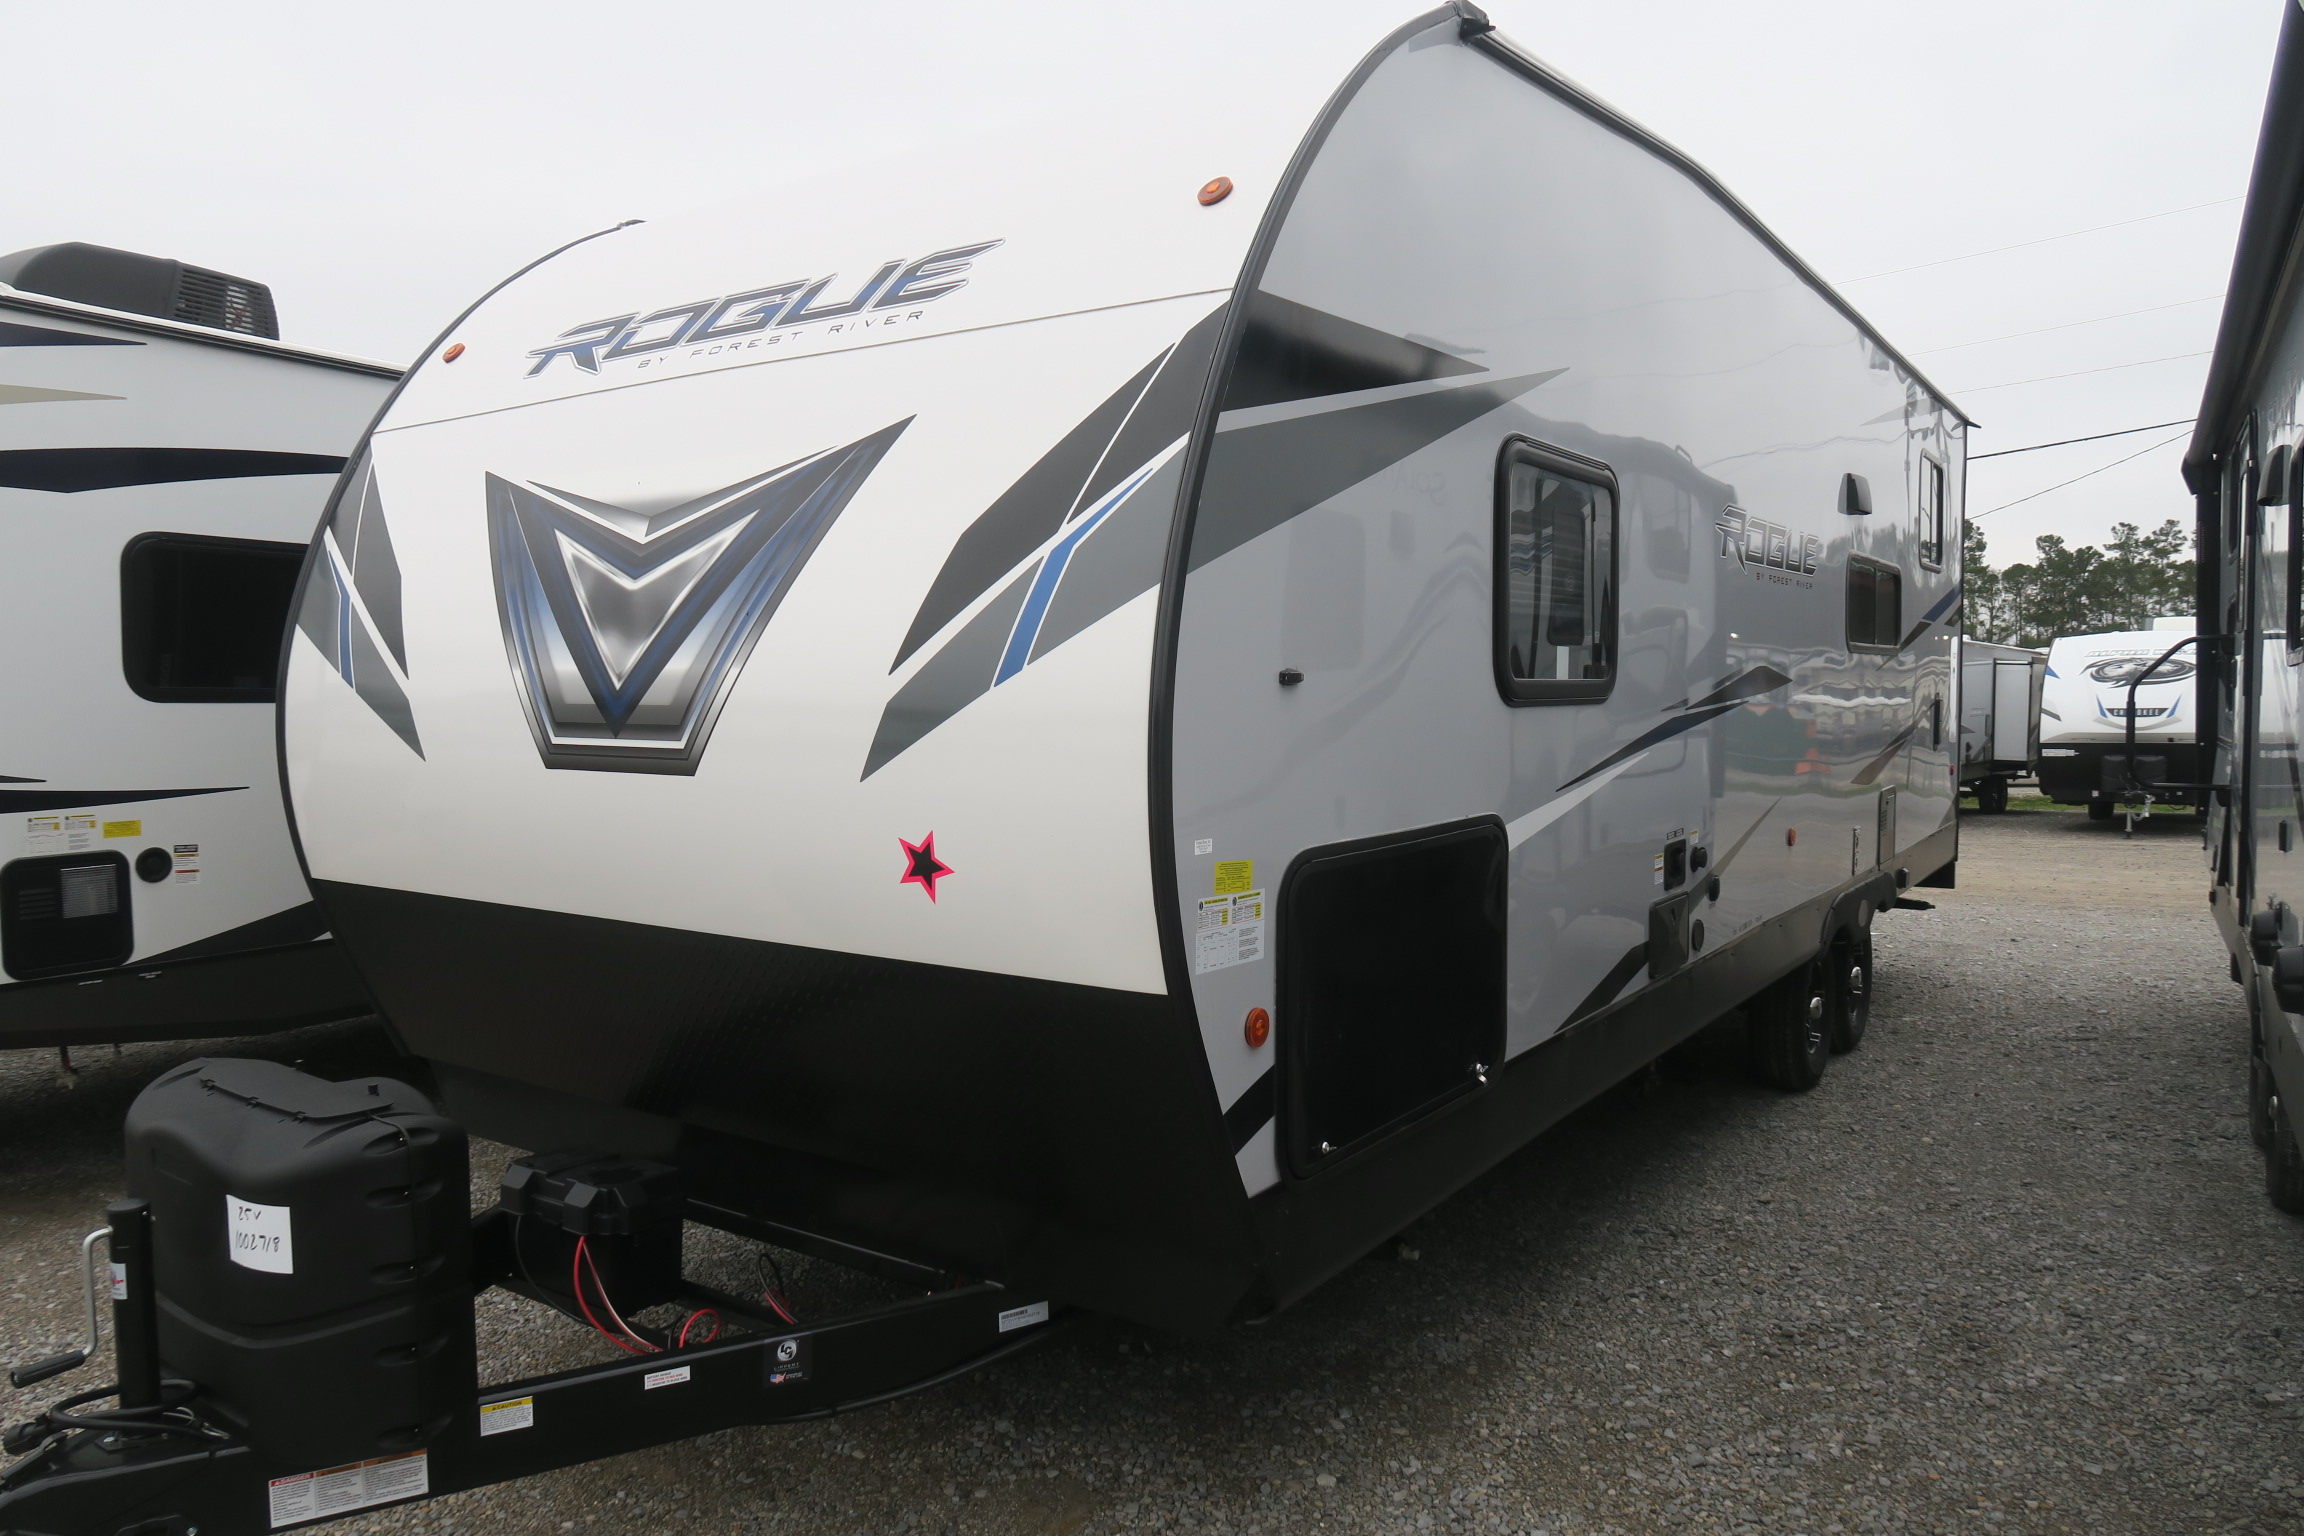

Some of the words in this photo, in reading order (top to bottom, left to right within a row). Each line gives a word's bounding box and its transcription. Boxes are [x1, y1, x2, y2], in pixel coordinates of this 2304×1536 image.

[523, 237, 1006, 379] ROGUE
[637, 355, 669, 369] BY
[689, 331, 805, 359] FOREST
[827, 310, 924, 335] RIVER
[1715, 504, 1819, 576] ROGUE
[1768, 574, 1793, 586] FOREST
[1796, 580, 1813, 590] RIVER
